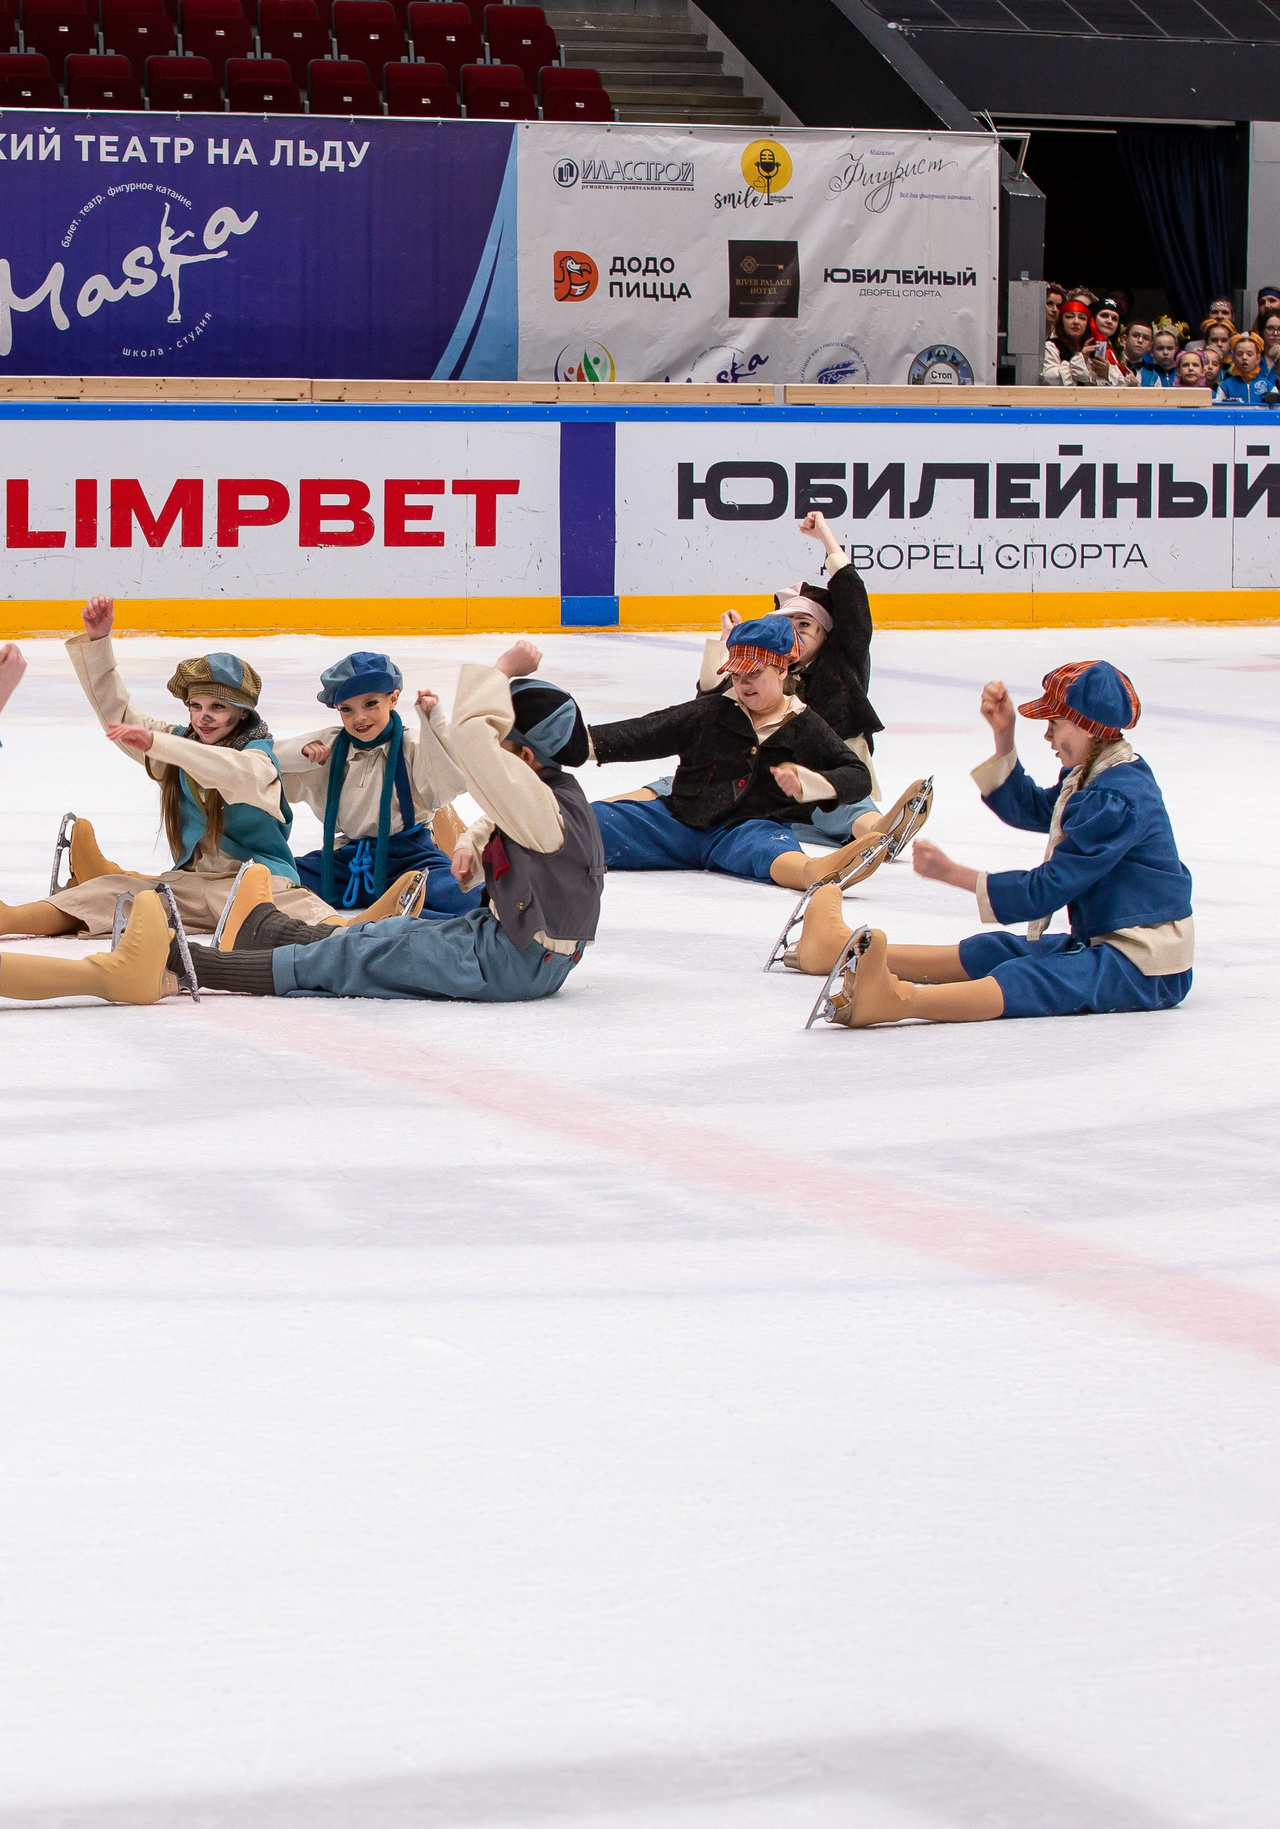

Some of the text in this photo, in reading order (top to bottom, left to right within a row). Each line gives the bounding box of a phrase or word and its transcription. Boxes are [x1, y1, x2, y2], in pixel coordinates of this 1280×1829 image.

[75, 135, 195, 164] ТЕАТР
[208, 138, 259, 166] НА
[270, 140, 371, 172] ЛЬДУ
[581, 159, 695, 182] ИЛАССТРОЙ
[824, 153, 959, 213] Фигурист
[714, 185, 763, 209] smile
[61, 182, 192, 248] балет. театр. фигурное катание.
[609, 256, 676, 276] ДОДО
[823, 265, 977, 287] ЮБИЛЕЙНЫЙ
[609, 281, 692, 302] ПИЦЦА
[735, 278, 792, 287] RIVER PALACE
[750, 287, 779, 295] HOTEL
[859, 288, 942, 298] ДВОРЕЦ СПОРТА
[122, 347, 164, 357] школа
[176, 312, 212, 348] студия
[931, 370, 953, 380] Стоп
[677, 445, 1280, 520] ЮБИЛЕЙНЫЙ
[995, 543, 1149, 571] СПОРТА
